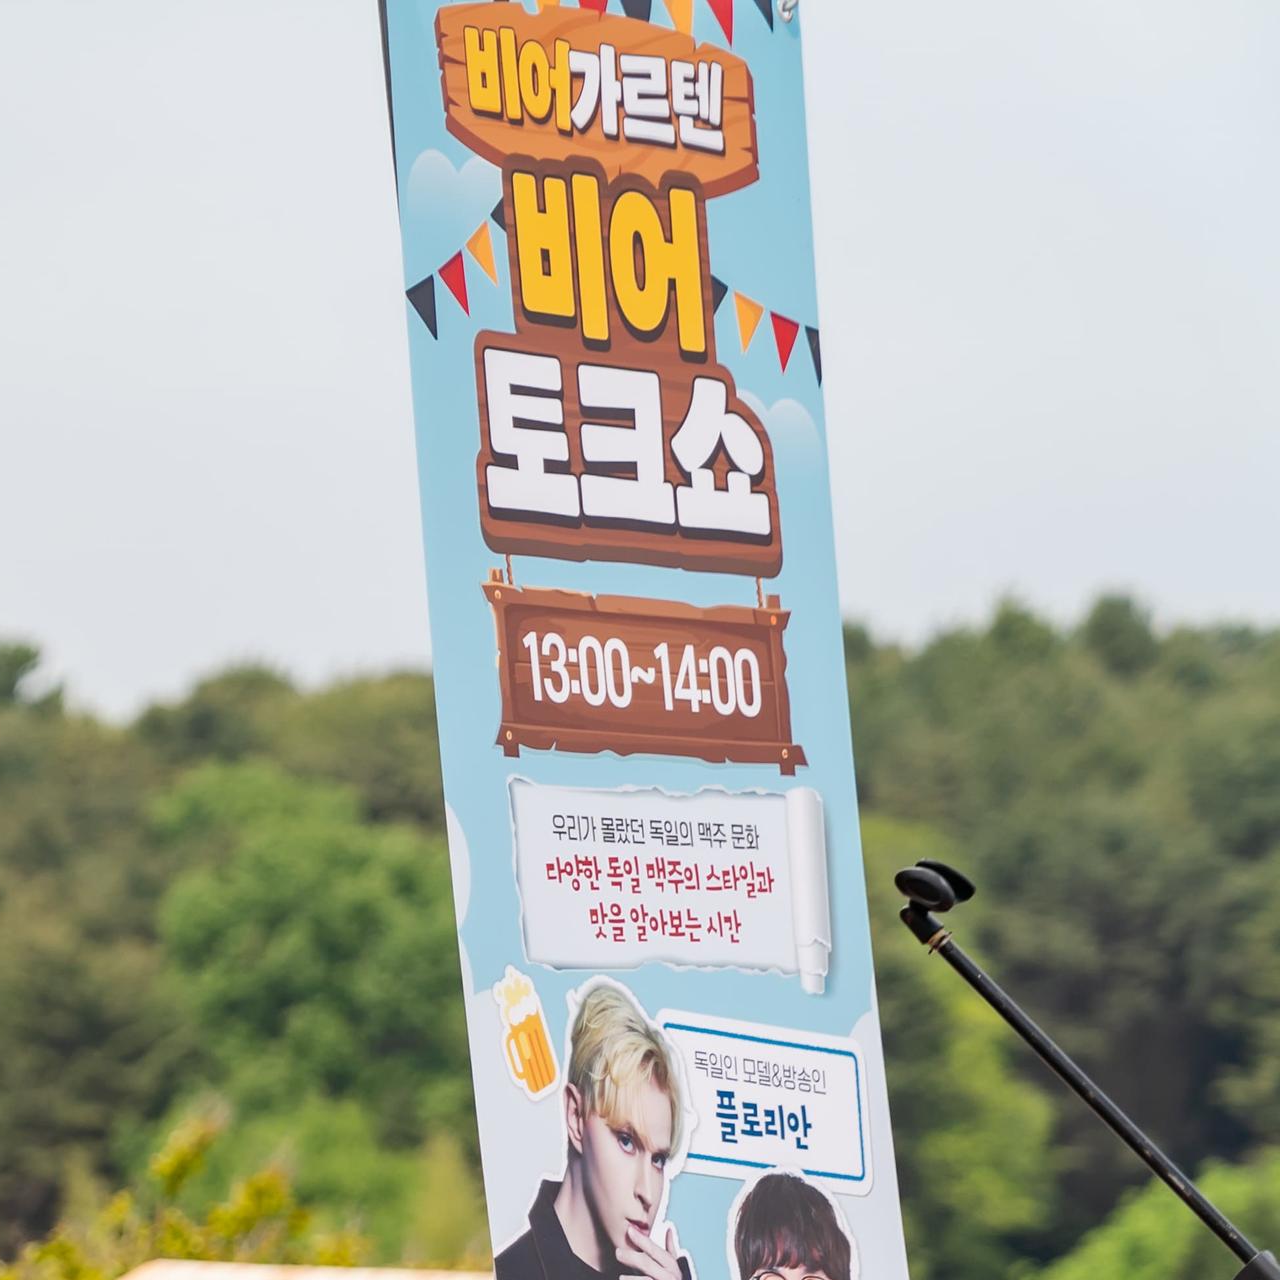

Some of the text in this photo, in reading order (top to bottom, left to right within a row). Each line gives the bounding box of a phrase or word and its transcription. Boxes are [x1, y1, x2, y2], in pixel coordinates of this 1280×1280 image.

[463, 26, 725, 152] 비어가르텐
[511, 171, 707, 360] 비어
[484, 347, 772, 540] 토크쇼
[522, 630, 762, 718] 13:00~14:00
[552, 814, 760, 850] 우리가 몰랐던 독일의 맥주 문화
[546, 854, 775, 899] 다양한 독일 맥주의 스타일과
[589, 902, 742, 944] 맛을 알아보는 시간
[694, 1050, 827, 1095] 독일인 모델&방송인
[716, 1089, 813, 1150] 플로리안
